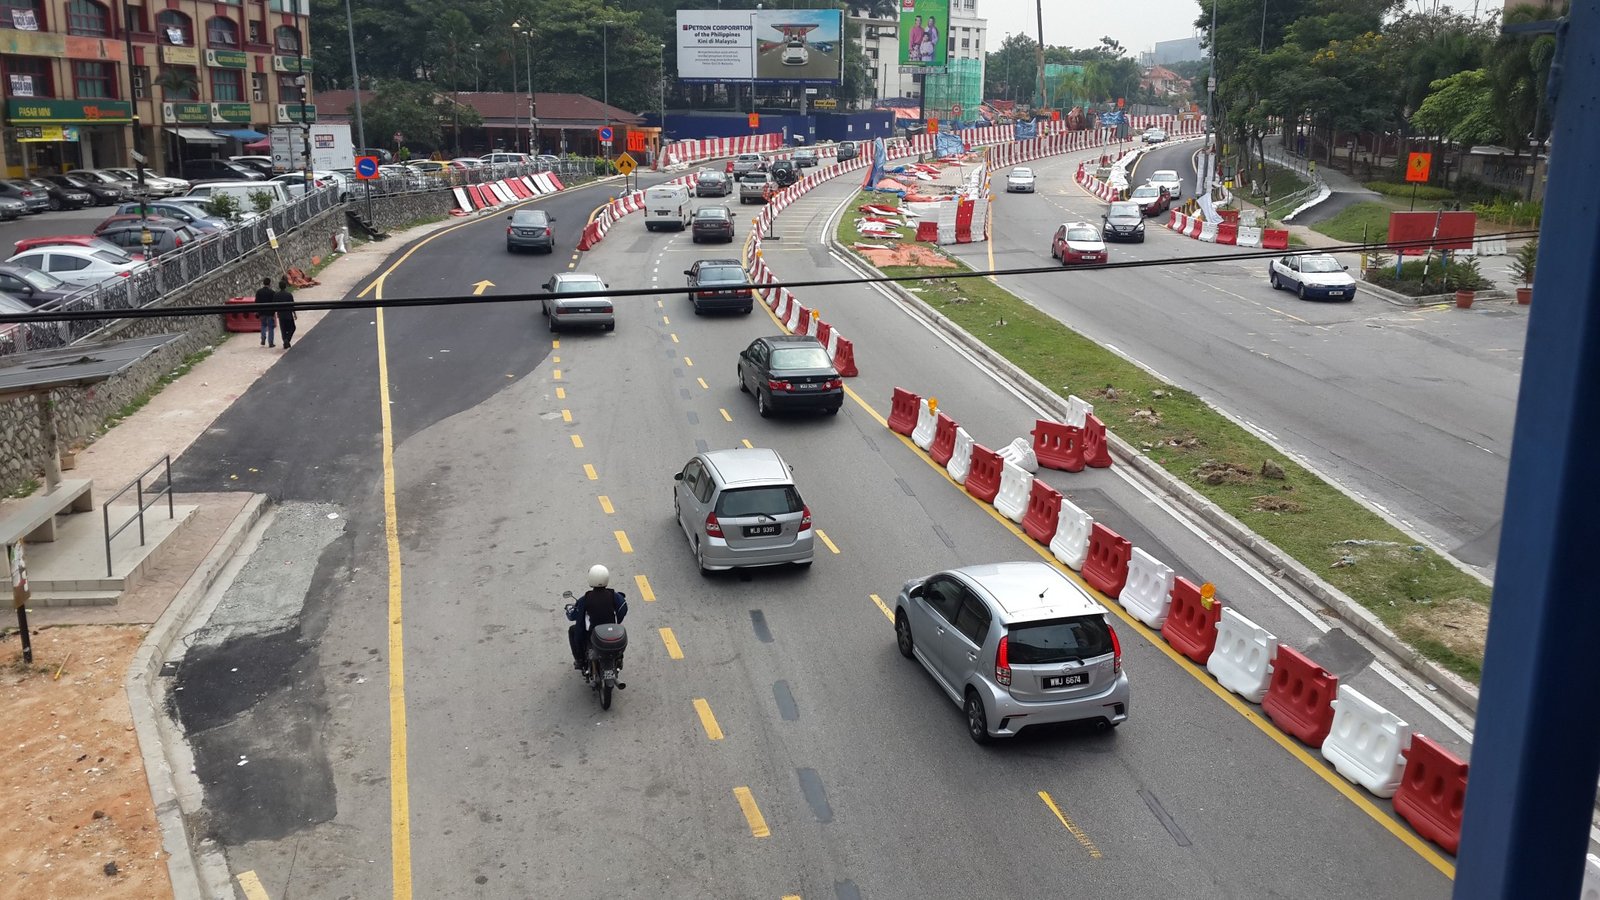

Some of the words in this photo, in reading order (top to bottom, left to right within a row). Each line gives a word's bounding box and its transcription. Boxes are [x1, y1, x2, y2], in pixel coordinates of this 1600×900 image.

[18, 107, 37, 116] PASAR
[1050, 678, 1063, 686] WWJ
[1066, 676, 1080, 684] 6674
